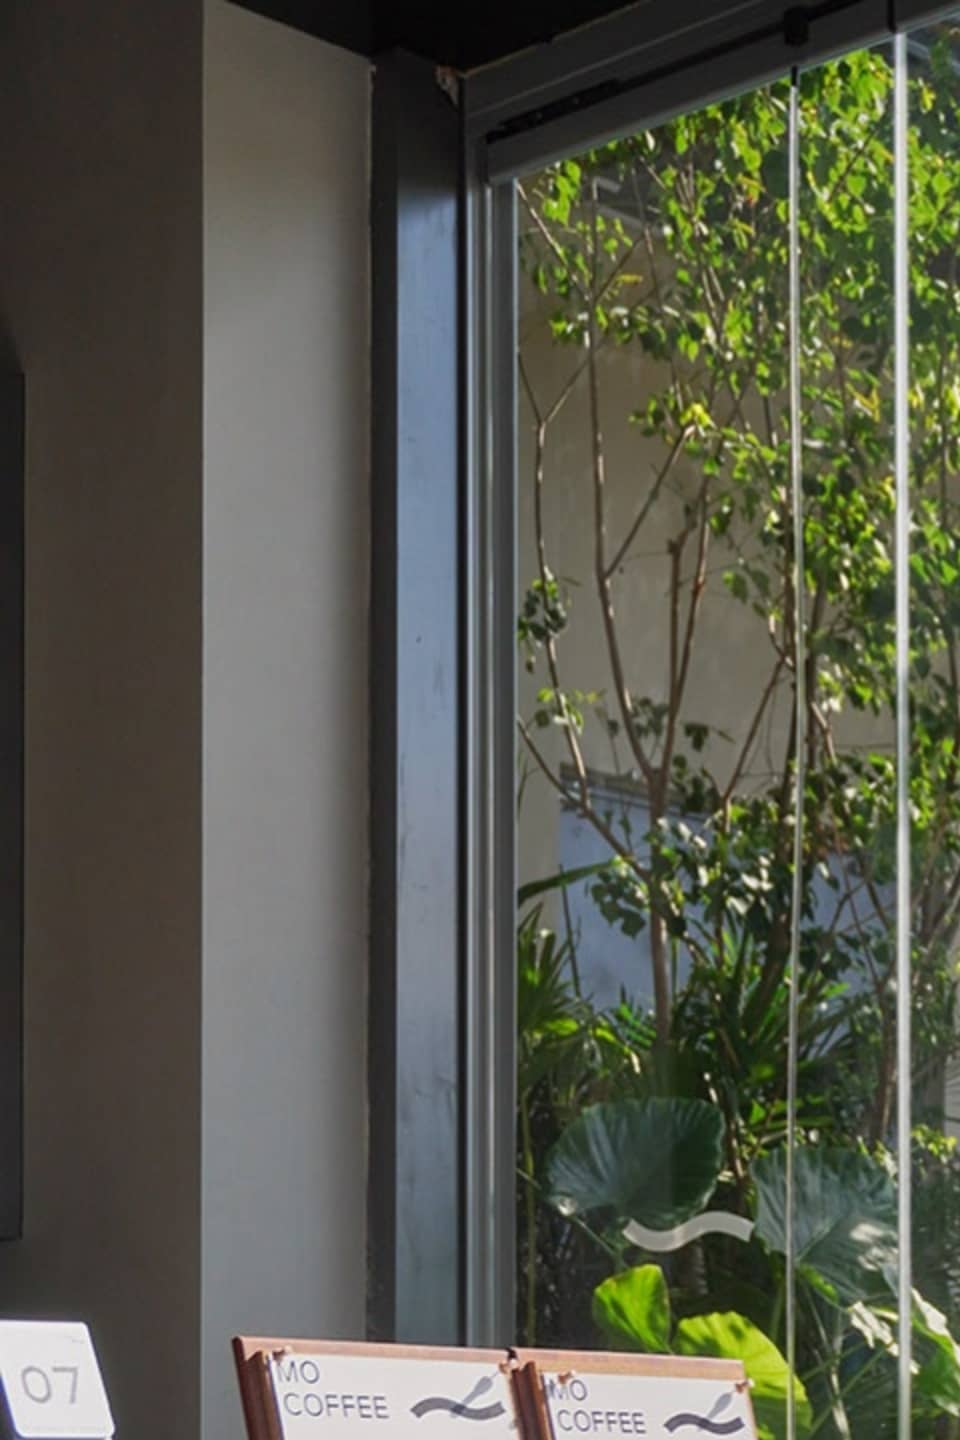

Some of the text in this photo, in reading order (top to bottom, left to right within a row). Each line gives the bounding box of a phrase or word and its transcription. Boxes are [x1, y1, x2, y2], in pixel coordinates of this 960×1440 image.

[21, 1366, 79, 1404] 07
[276, 1361, 320, 1384] MO
[547, 1379, 588, 1401] MO
[283, 1392, 389, 1419] COFFEE
[558, 1409, 646, 1434] COFFEE
